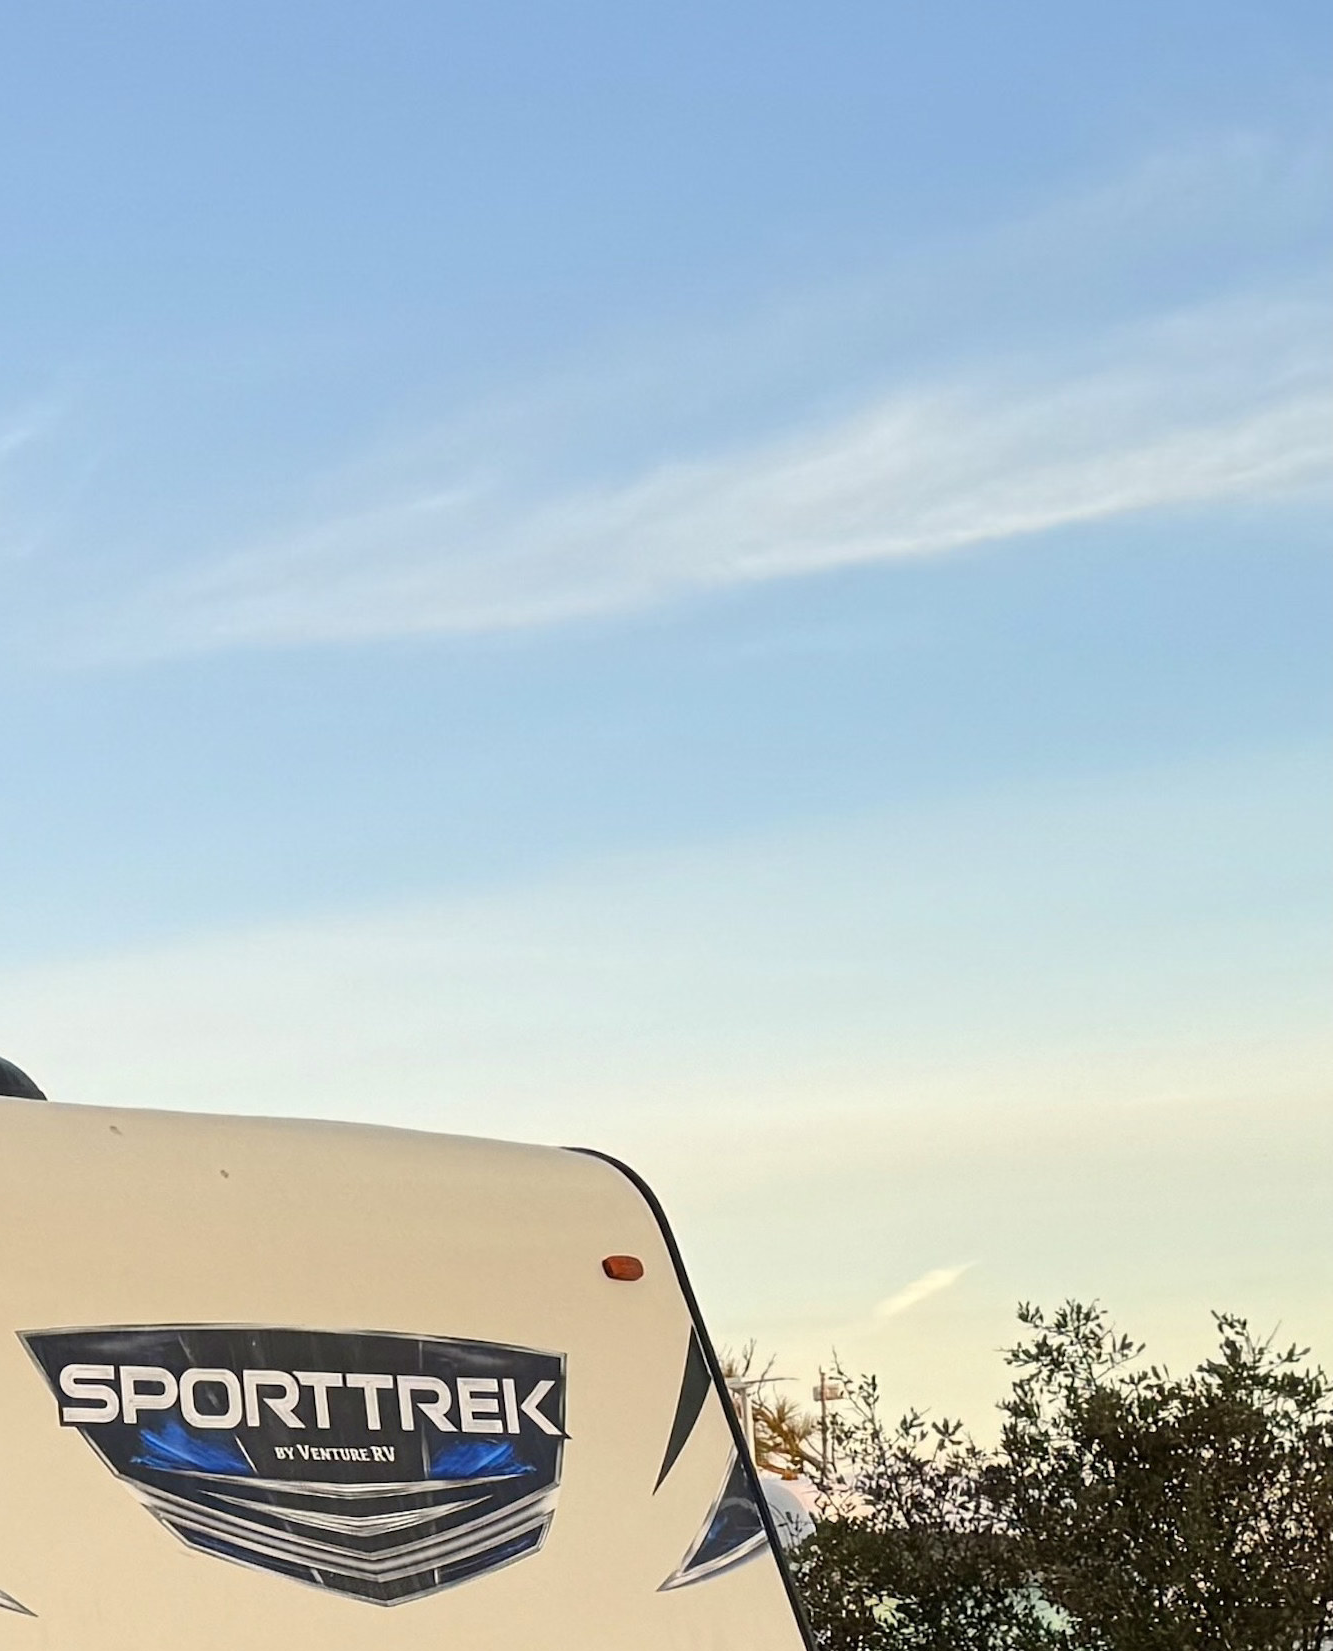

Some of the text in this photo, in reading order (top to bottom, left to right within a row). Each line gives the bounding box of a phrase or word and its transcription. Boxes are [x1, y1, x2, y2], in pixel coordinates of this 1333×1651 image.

[59, 1363, 564, 1436] SPORTTREK
[274, 1444, 395, 1462] BY VENTURE RV
